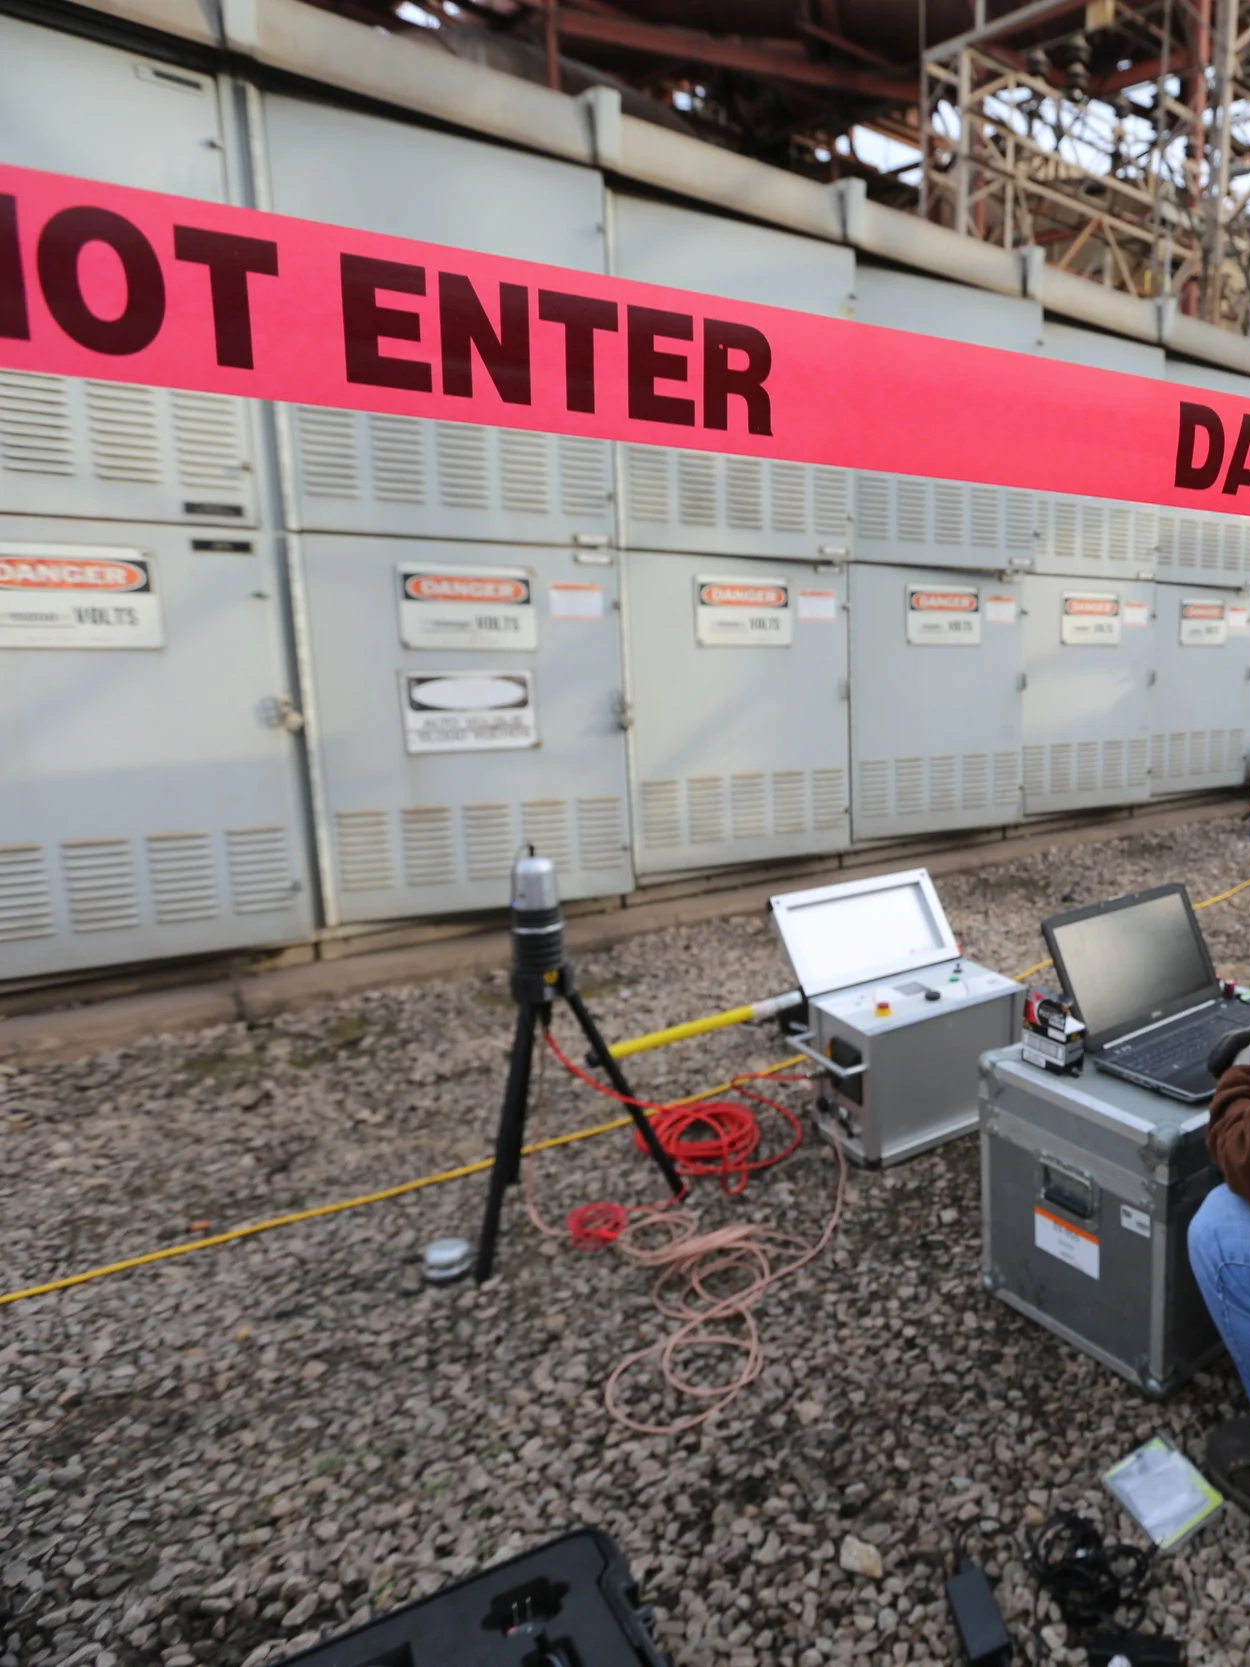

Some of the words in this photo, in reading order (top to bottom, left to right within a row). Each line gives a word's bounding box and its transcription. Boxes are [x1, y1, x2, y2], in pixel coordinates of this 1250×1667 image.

[340, 252, 773, 437] ENTER
[419, 583, 515, 599] DANGER
[711, 588, 776, 603] DANGER
[73, 606, 139, 626] VOLTS
[475, 616, 520, 632] VOLTS
[750, 617, 779, 631] VOLTS
